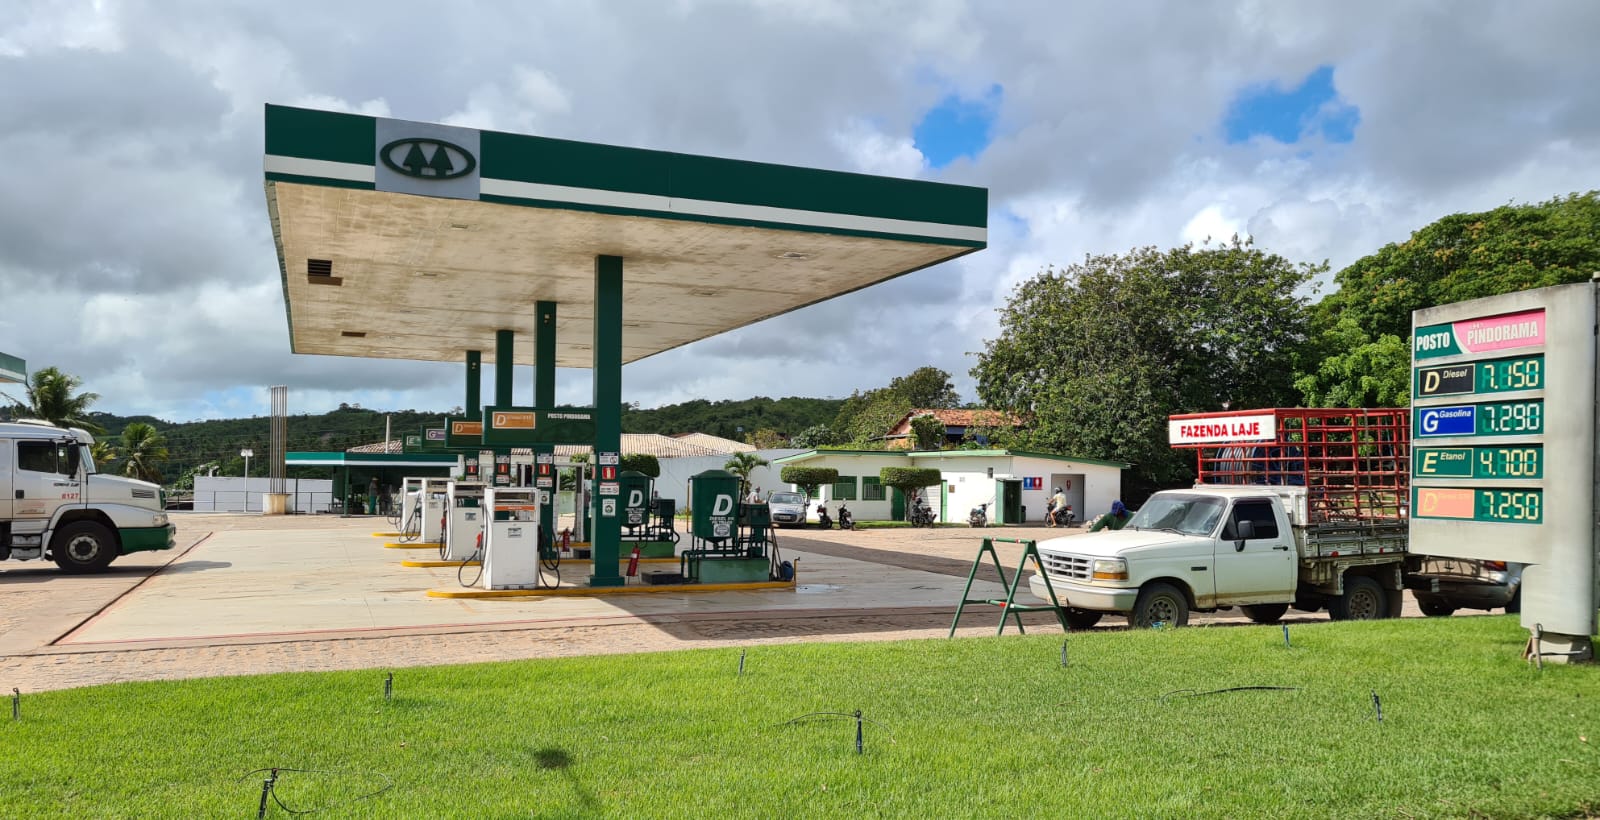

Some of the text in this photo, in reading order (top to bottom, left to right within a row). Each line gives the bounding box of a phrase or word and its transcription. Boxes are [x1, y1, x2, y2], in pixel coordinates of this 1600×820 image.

[1416, 321, 1538, 351] POSTO PINDORAMA
[1424, 360, 1539, 392] D Diesel 7.150
[496, 414, 506, 426] D
[1181, 422, 1260, 437] FAZENDA LAJE
[1423, 403, 1539, 432] G Gasolina 7.290
[428, 430, 436, 439] G
[1422, 449, 1537, 476] E Etanol 4.700
[628, 489, 643, 508] D
[712, 494, 733, 516] D
[1422, 491, 1539, 520] D 7.250
